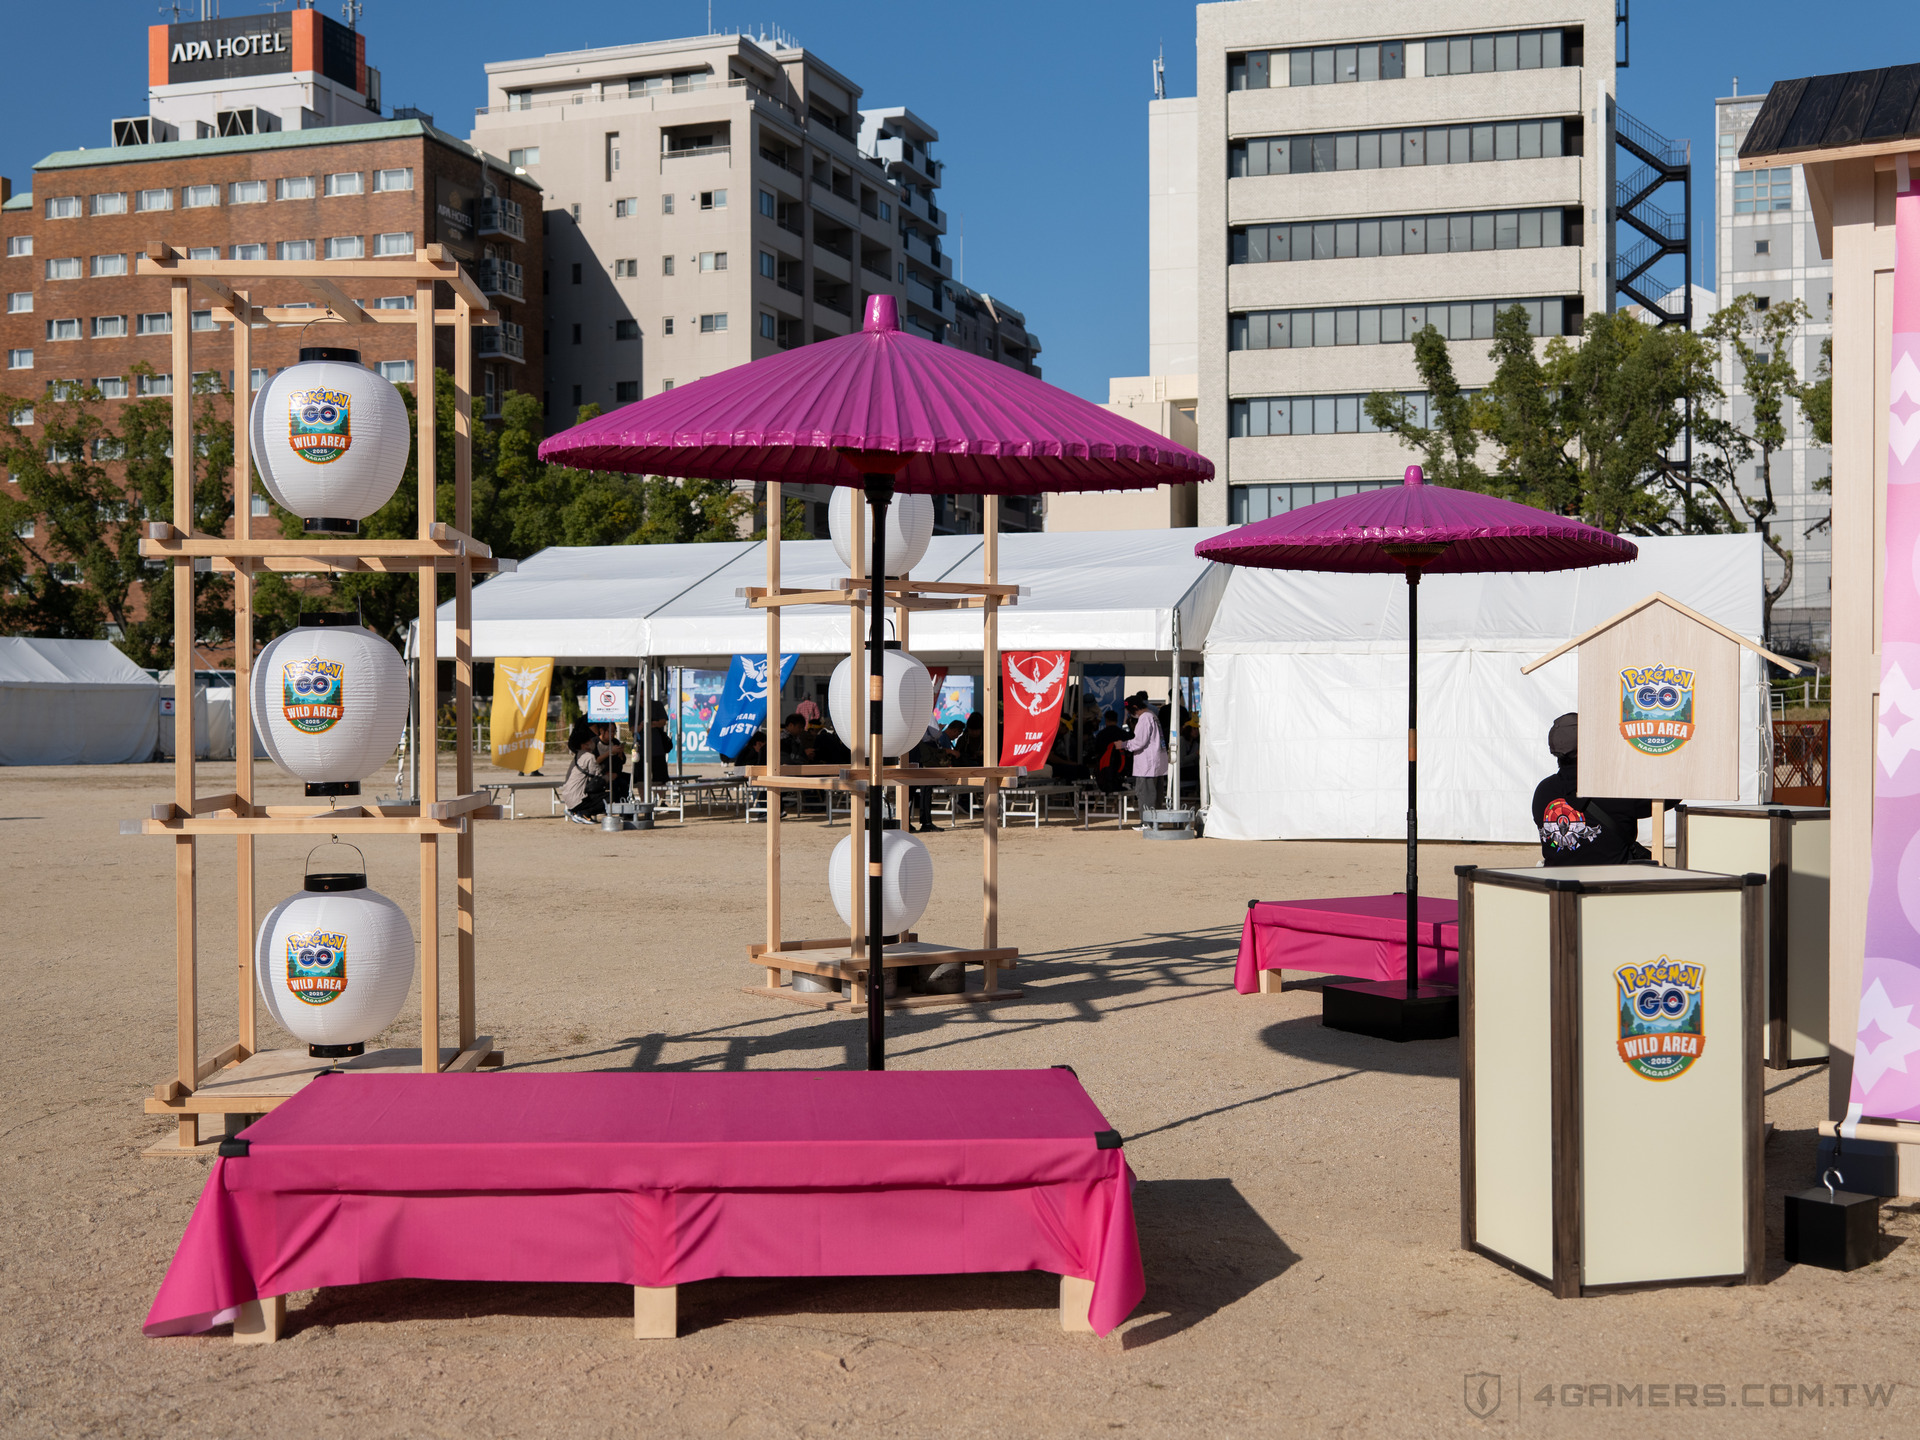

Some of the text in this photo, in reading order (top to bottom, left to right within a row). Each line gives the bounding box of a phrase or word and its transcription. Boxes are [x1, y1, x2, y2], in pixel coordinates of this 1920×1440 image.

[171, 33, 286, 63] APA HOTEL
[302, 405, 338, 424] GO
[293, 435, 346, 449] WILD AREA
[304, 453, 336, 462] NAGASAKI
[294, 675, 330, 695] GO
[1637, 686, 1679, 708] GO
[287, 706, 338, 719] WILD AREA
[297, 723, 329, 732] NAGASAKI
[1625, 722, 1688, 738] WILD AREA
[674, 730, 717, 752] 202
[1025, 732, 1044, 740] TEAM
[1013, 741, 1044, 756] VALOR
[1637, 743, 1675, 753] NAGASAKI
[298, 948, 334, 968] GO
[291, 979, 342, 991] WILD AREA
[301, 995, 333, 1004] NAGASAKI
[1637, 988, 1686, 1017] GO
[1624, 1035, 1698, 1058] WILD AREA
[1650, 1056, 1672, 1065] 2025
[1639, 1063, 1684, 1077] NAGASAKI
